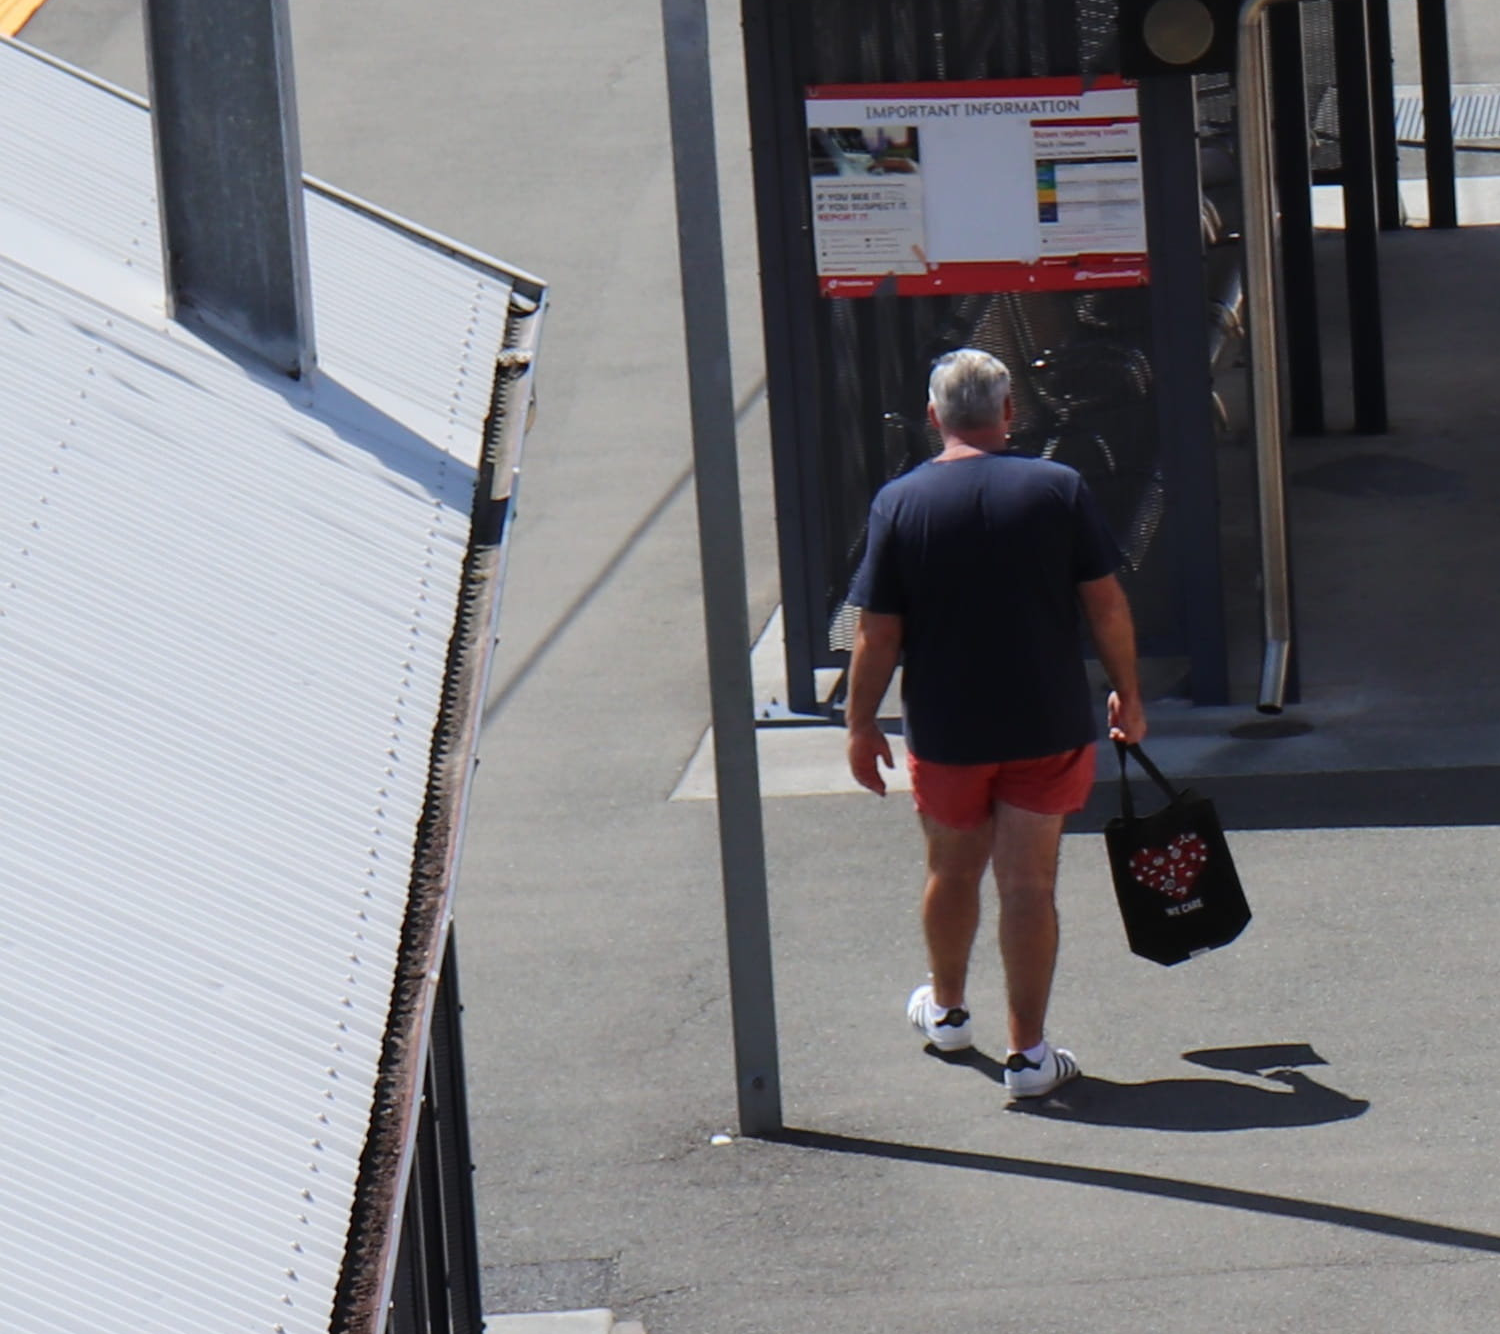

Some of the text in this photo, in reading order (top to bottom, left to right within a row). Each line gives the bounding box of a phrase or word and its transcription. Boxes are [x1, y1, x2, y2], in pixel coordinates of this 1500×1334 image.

[866, 99, 1080, 119] IMPORTANT INFORMATION
[828, 193, 848, 201] YOU
[851, 192, 869, 201] SEE
[829, 203, 849, 211] YOU
[852, 202, 896, 211] SUSPECT
